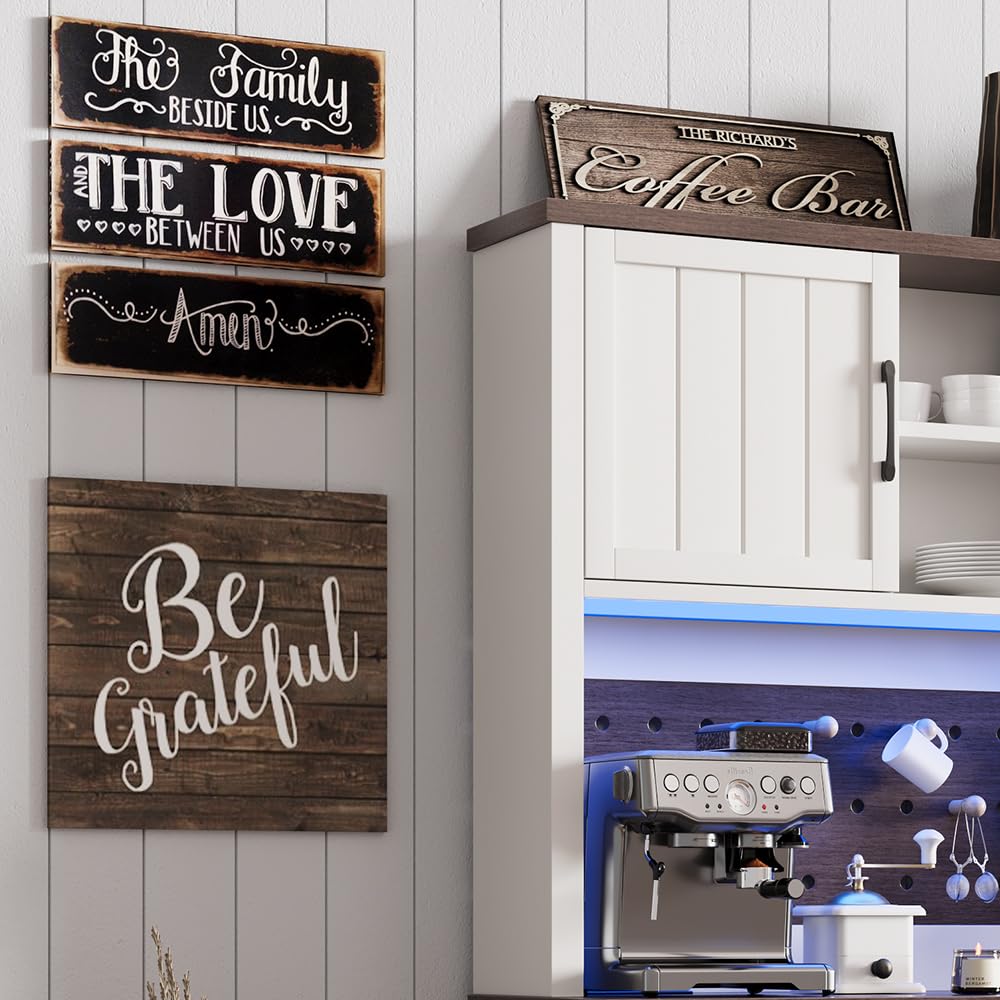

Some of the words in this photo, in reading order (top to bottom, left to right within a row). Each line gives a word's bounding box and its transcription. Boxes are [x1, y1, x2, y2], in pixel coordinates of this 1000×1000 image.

[92, 28, 180, 91] The
[209, 42, 348, 124] Family
[168, 96, 238, 131] BESIDE
[678, 126, 712, 142] THE
[715, 129, 798, 150] RICHARD'S
[73, 164, 89, 199] AND
[75, 152, 184, 217] THE
[209, 164, 359, 235] LOVE
[574, 145, 763, 210] Coffee
[771, 169, 894, 220] Bar
[145, 217, 241, 254] BETWEEN
[259, 227, 286, 257] US
[121, 542, 265, 674] Be
[93, 576, 359, 793] Grateful
